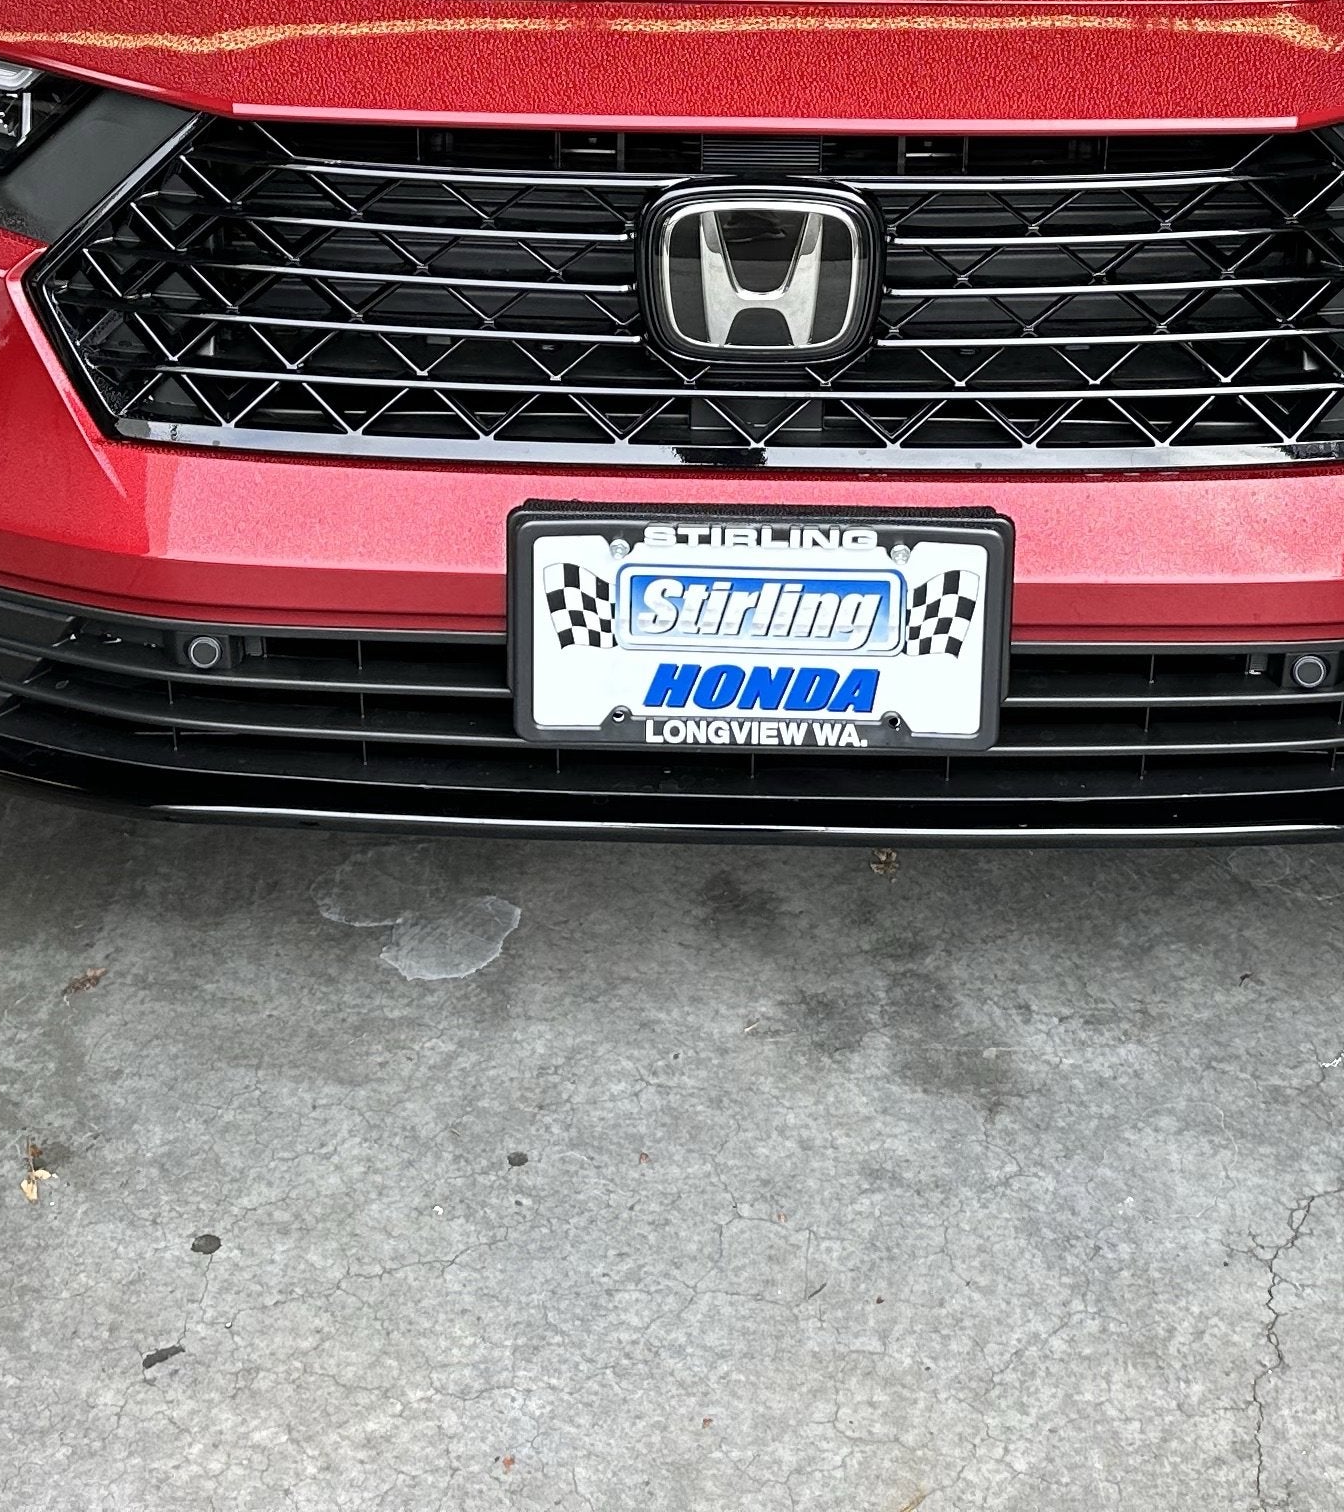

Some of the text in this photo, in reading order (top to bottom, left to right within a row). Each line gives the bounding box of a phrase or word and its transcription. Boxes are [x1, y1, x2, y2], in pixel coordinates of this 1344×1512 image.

[643, 526, 878, 550] STIRLING
[640, 578, 883, 651] Stirling
[643, 664, 880, 713] HONDA
[645, 719, 868, 748] LONGVIEW WA.
